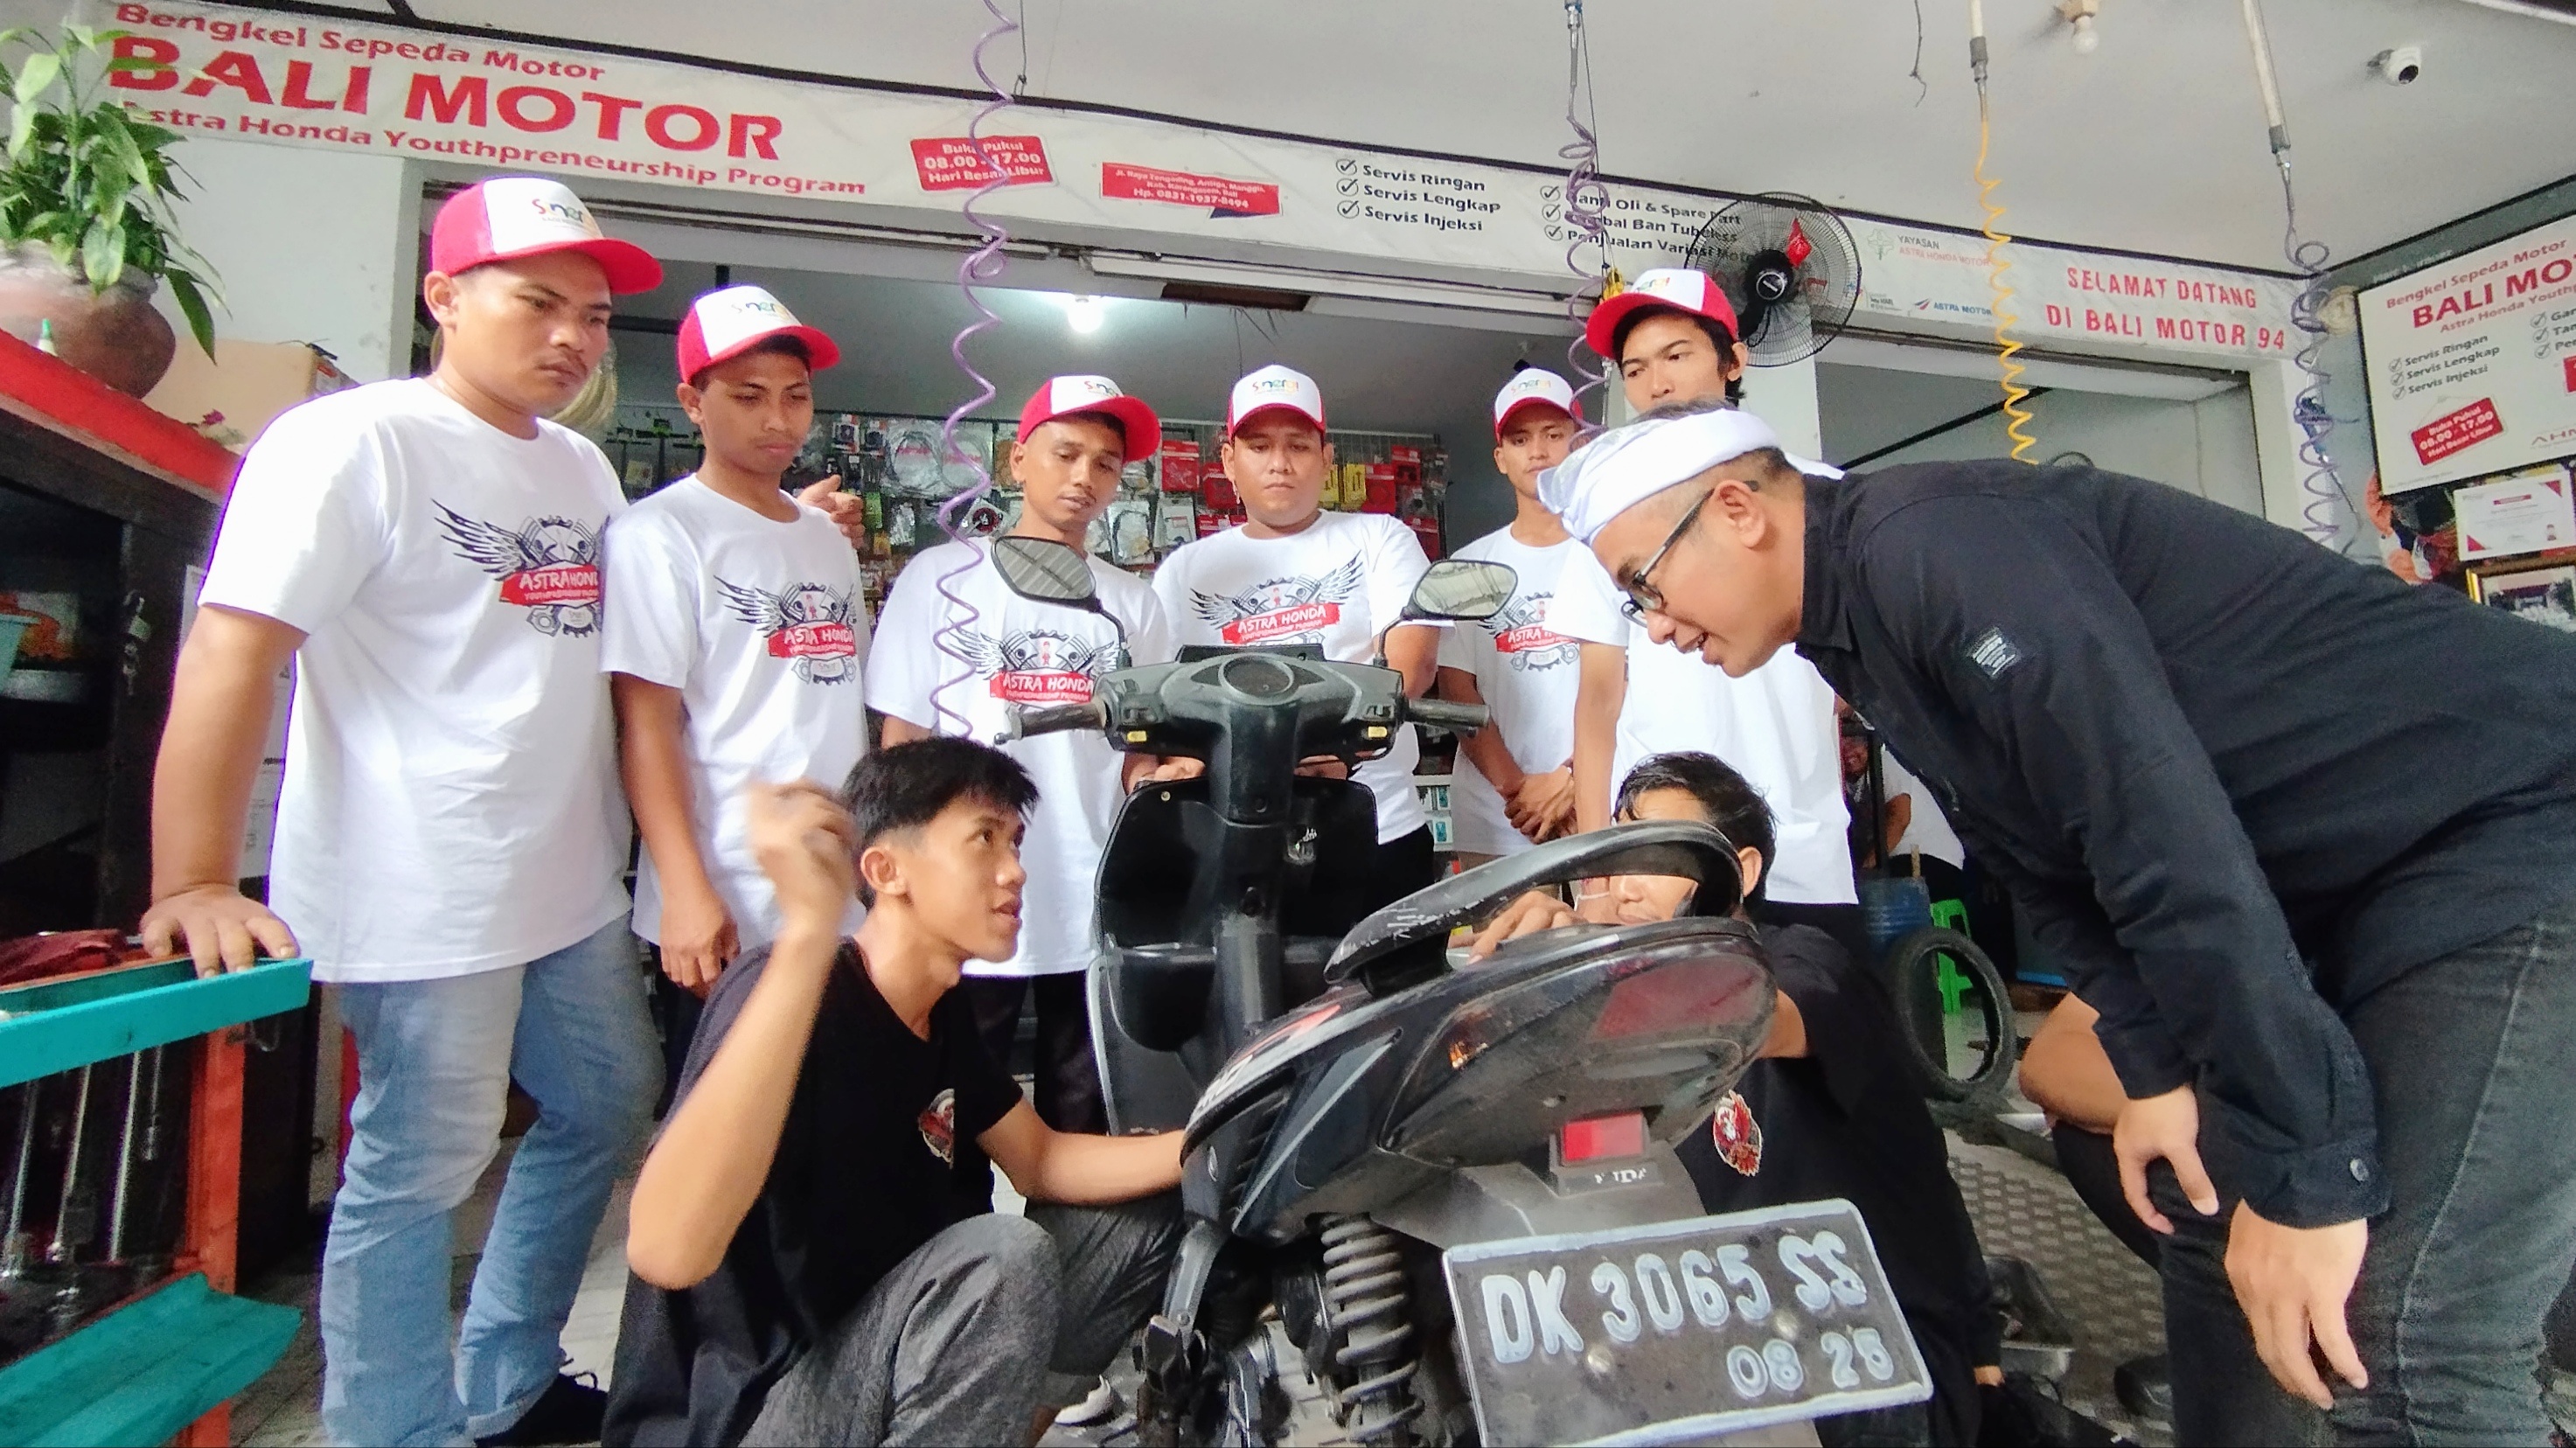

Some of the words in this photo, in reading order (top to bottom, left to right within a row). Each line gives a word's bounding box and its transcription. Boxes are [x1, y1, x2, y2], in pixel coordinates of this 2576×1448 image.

[115, 3, 307, 47] Bengkel
[319, 30, 470, 63] Sepeda
[483, 50, 606, 80] Motor
[109, 35, 372, 115] BALI
[404, 73, 783, 161] MOTOR
[239, 115, 372, 145] Honda
[384, 130, 717, 185] Youthpreneurship
[728, 167, 867, 194] Program
[924, 155, 978, 170] 08.00
[992, 151, 1041, 166] 17.00
[983, 141, 1024, 153] Pukul
[928, 170, 961, 184] Hari
[1362, 164, 1417, 182] Servis
[1421, 174, 1485, 191] Ringan
[1363, 184, 1417, 202] Servis
[1424, 192, 1501, 213] Lengkap
[1616, 198, 1640, 211] Oli
[1645, 202, 1657, 212] &
[1660, 204, 1706, 219] Spare
[1365, 205, 1418, 223] Servis
[1424, 212, 1482, 231] Injeksi
[1633, 219, 1665, 232] Ban
[1897, 234, 1940, 250] YAYASAN
[1899, 247, 1925, 258] ASTRA
[2067, 267, 2168, 298] SELAMAT
[2176, 280, 2257, 309] DATANG
[2386, 280, 2447, 310] Bengkel
[2450, 261, 2509, 286] Sepeda
[2513, 239, 2567, 264] Motor
[2412, 282, 2495, 329] BALI
[2505, 254, 2576, 298] MO
[1933, 303, 1960, 312] ASTRA
[2440, 317, 2475, 333] Astra
[2478, 301, 2525, 321] Honda
[2046, 304, 2071, 329] DI
[2085, 309, 2142, 338] BALI
[2155, 317, 2245, 346] MOTOR
[2257, 327, 2285, 350] 94
[2405, 350, 2440, 366] Servis
[2442, 335, 2489, 354] Ringan
[2406, 363, 2441, 379] Servis
[2444, 346, 2501, 367] Lengkap
[2408, 378, 2443, 394] Servis
[2446, 364, 2489, 383] Injeksi
[519, 571, 568, 591] ASTRA
[1237, 616, 1278, 634] ASTRA
[1281, 605, 1326, 624] HONDA
[1507, 629, 1542, 644] ASTRA
[1002, 672, 1043, 692] ASTRA
[1047, 677, 1095, 693] HONDA
[1479, 1264, 1585, 1364] DK
[1590, 1242, 1772, 1344] 3065
[1778, 1229, 1868, 1312] SS
[1725, 1337, 1805, 1399] 08
